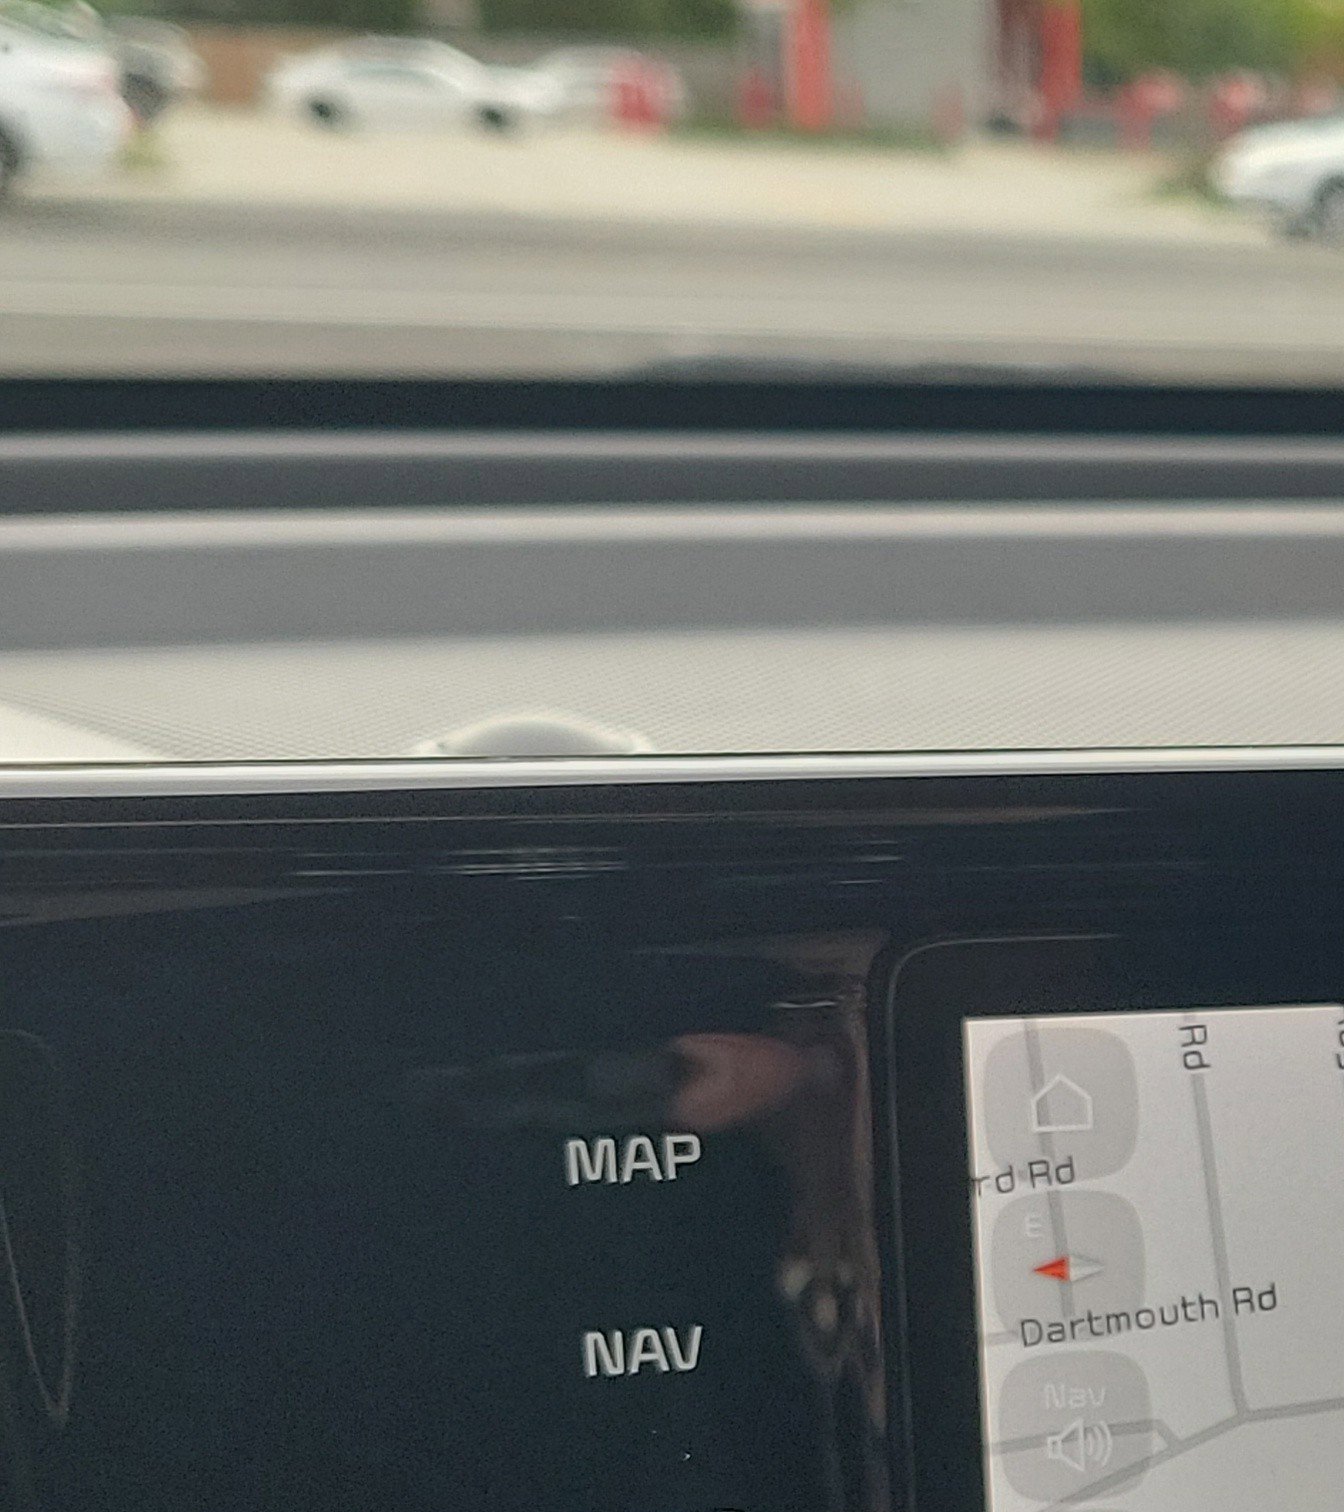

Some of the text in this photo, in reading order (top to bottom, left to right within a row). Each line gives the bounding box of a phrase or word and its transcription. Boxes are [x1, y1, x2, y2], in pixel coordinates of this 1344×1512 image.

[1178, 1023, 1211, 1072] Rd
[566, 1133, 702, 1187] MAP
[1027, 1155, 1076, 1189] Rd
[1020, 1282, 1279, 1348] Dartmouth Rd
[583, 1324, 703, 1378] NAV
